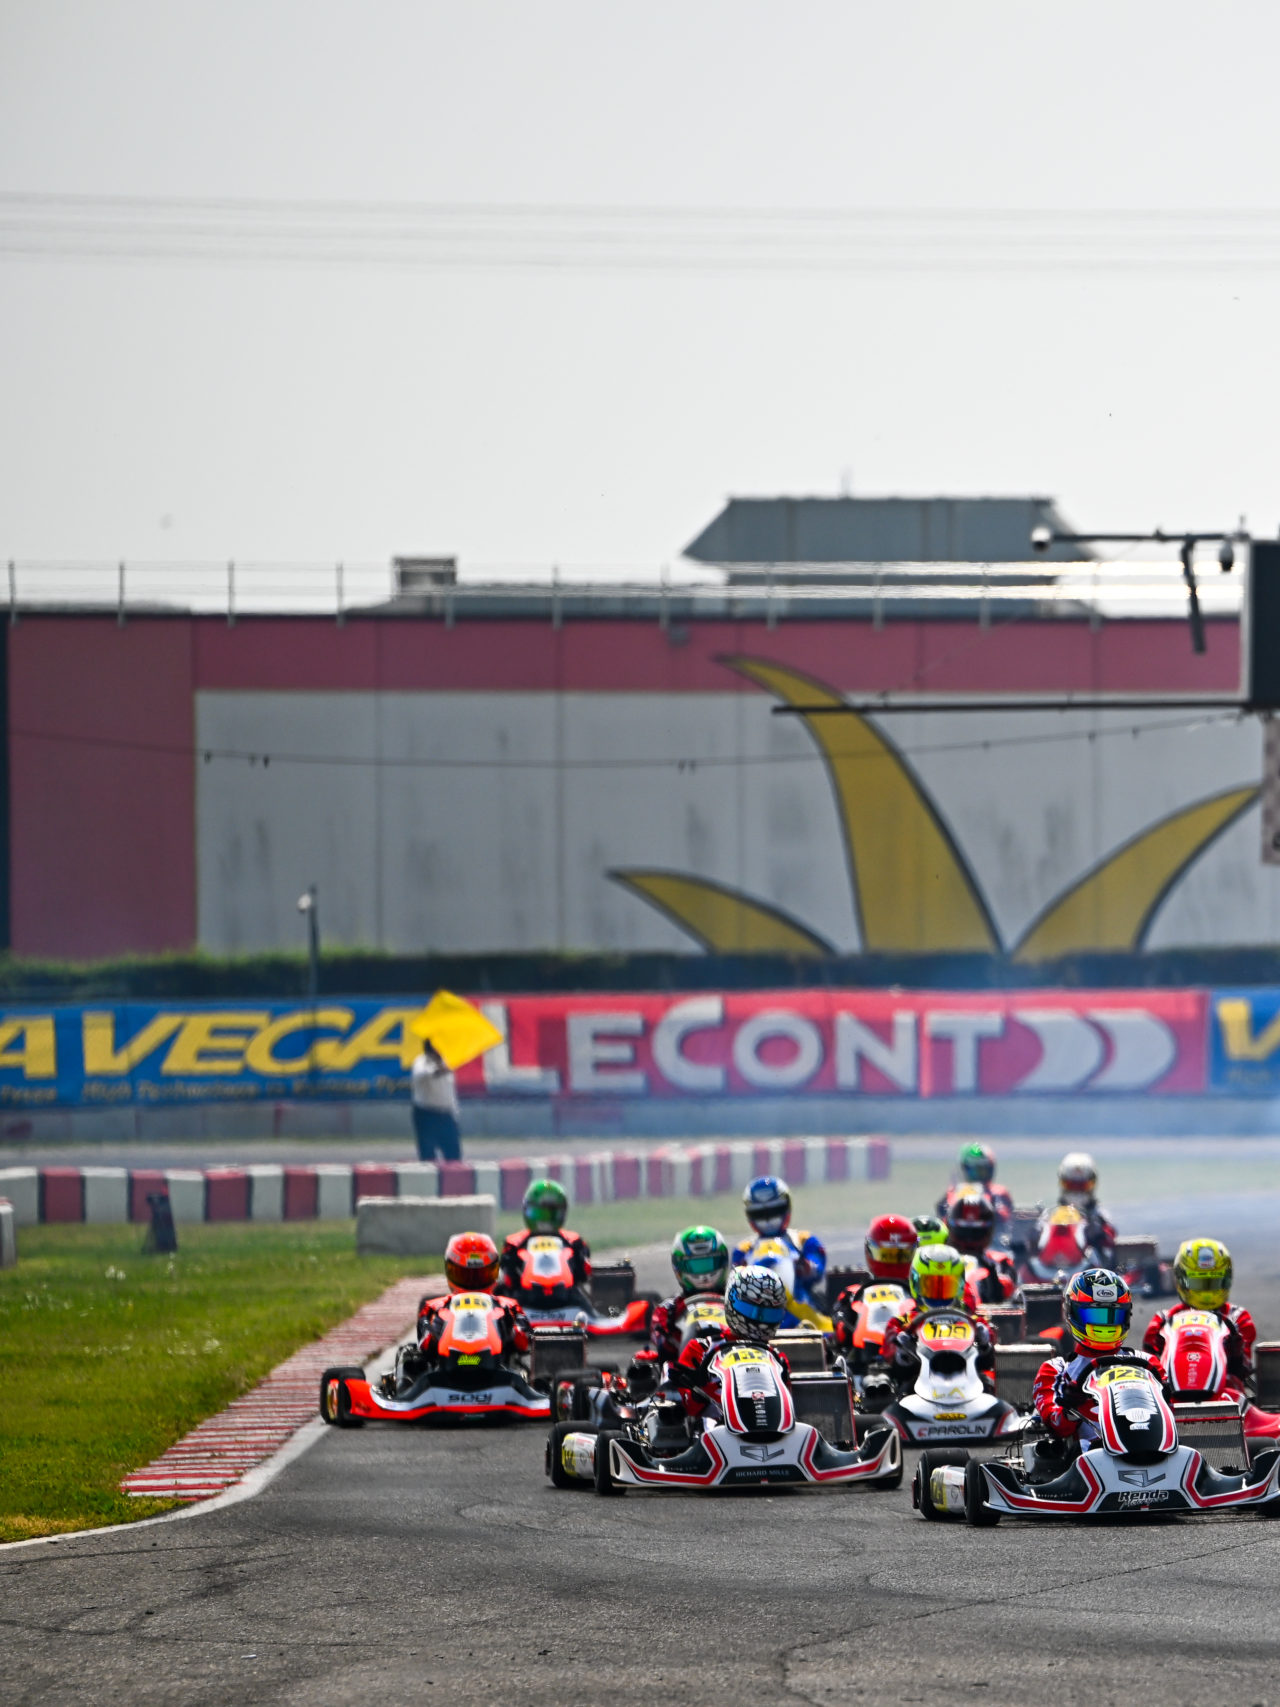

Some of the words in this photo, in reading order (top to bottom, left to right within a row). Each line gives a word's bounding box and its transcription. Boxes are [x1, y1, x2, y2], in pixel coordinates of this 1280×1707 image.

[82, 1006, 424, 1077] VEGA
[927, 1424, 987, 1436] PAROLIN
[1118, 1490, 1169, 1501] Renda
